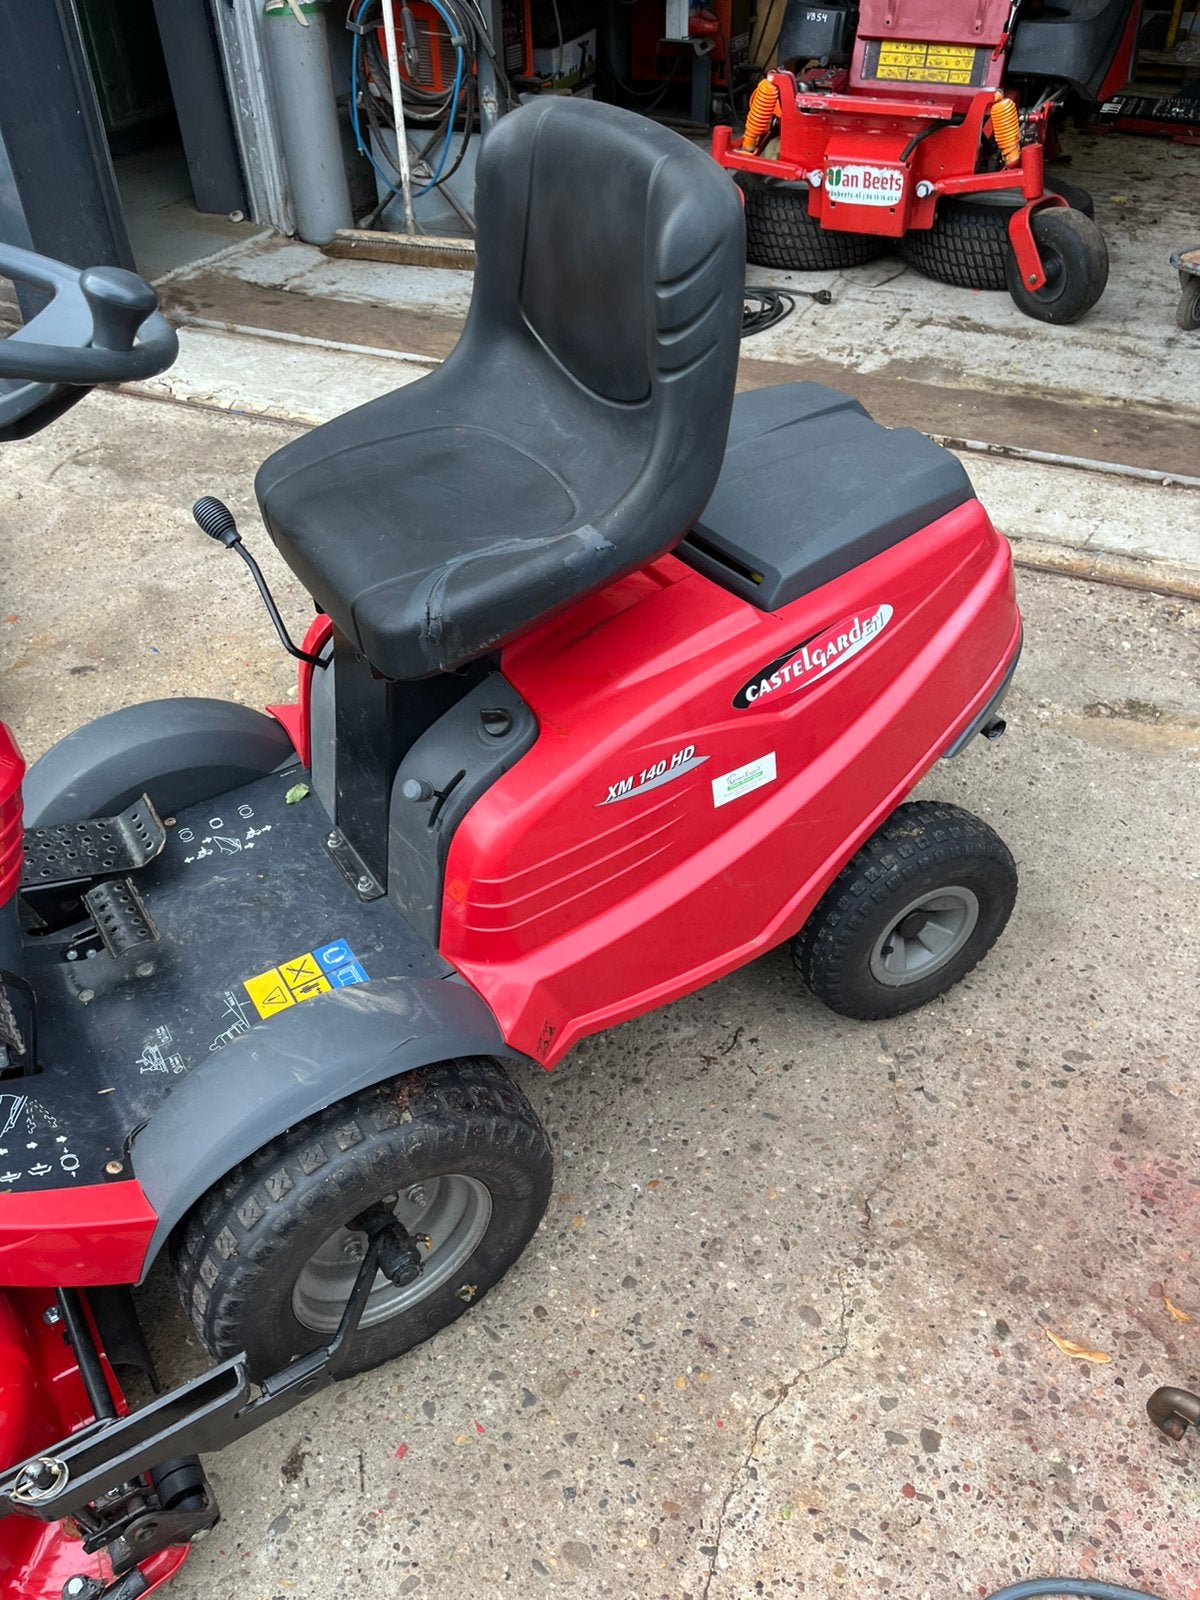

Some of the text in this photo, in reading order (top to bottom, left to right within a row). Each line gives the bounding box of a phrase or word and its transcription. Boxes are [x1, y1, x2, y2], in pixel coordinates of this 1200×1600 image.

[863, 171, 902, 191] Beets
[605, 745, 696, 803] XM 140 HD
